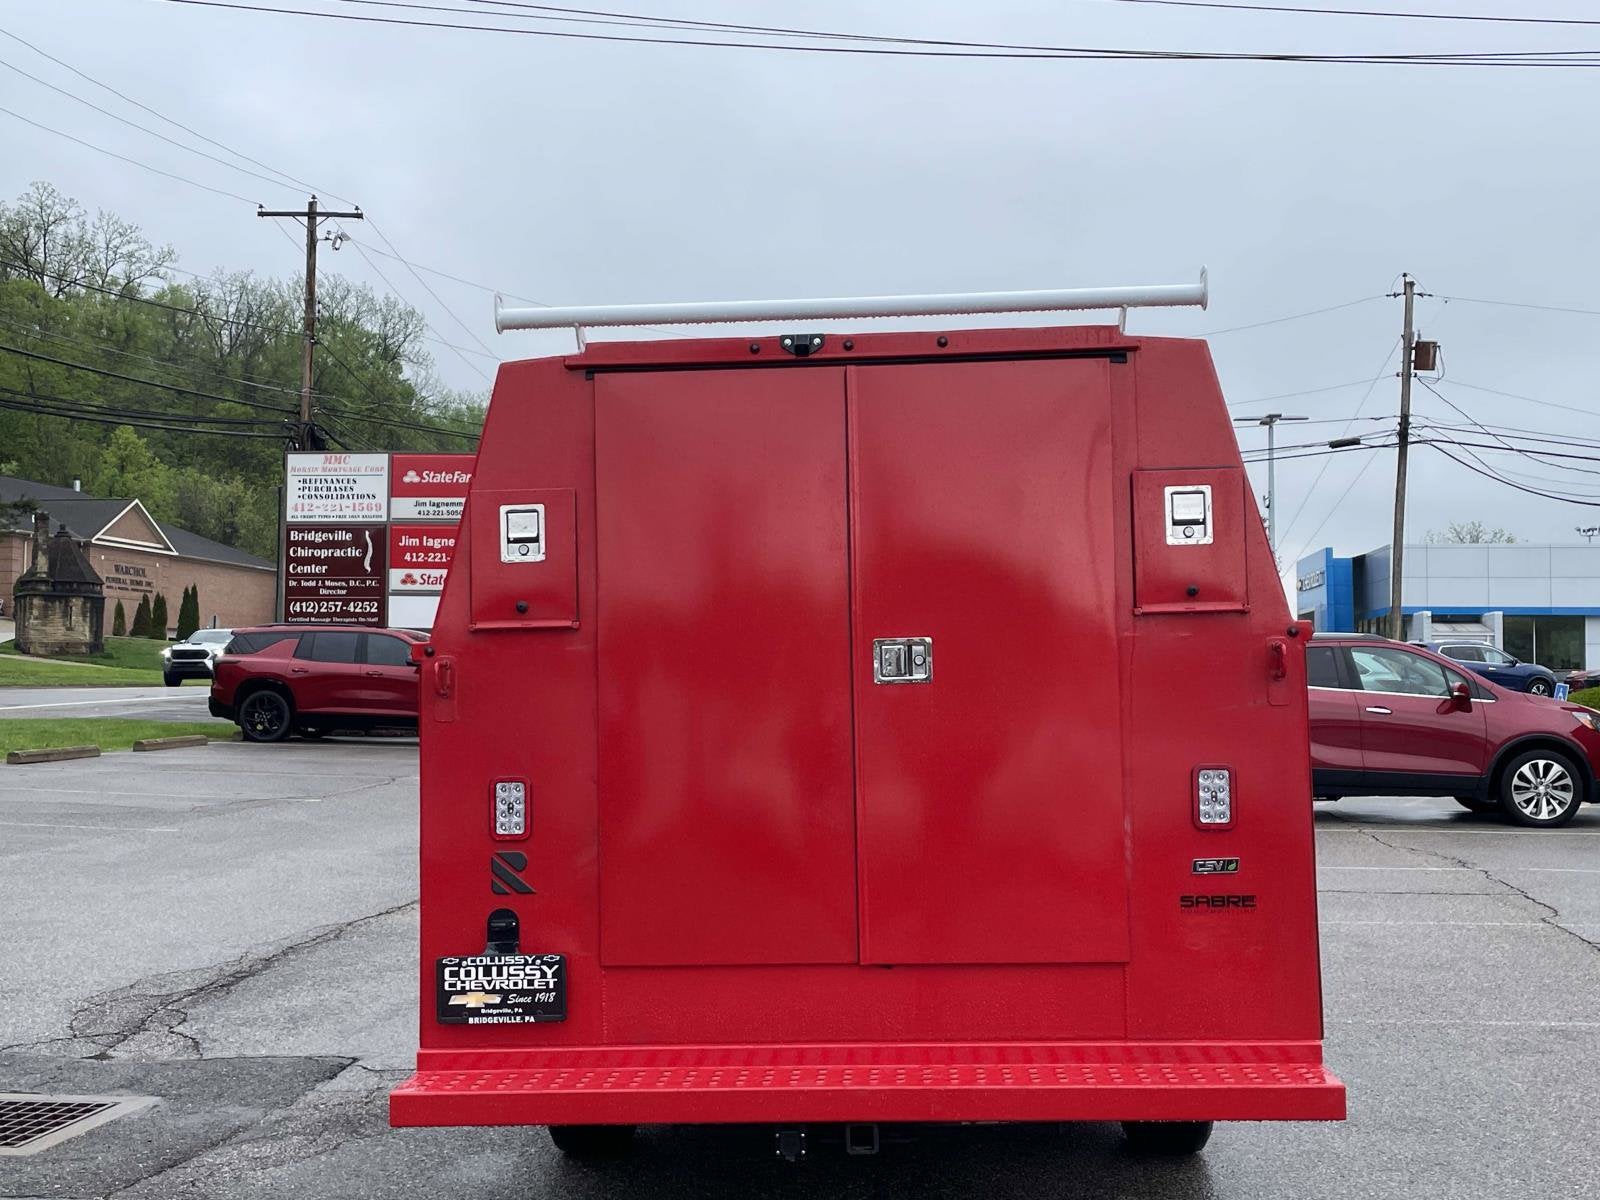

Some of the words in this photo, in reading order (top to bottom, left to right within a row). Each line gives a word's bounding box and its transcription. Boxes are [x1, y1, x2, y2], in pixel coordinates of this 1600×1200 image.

[323, 455, 351, 465] MMC
[421, 470, 472, 483] StateFar
[292, 502, 382, 512] 412-221-1569
[429, 500, 463, 509] Iagnemm
[290, 530, 352, 543] Bridgeville
[398, 536, 419, 547] Jim
[423, 536, 455, 549] Iagne
[289, 546, 362, 559] Chiropractic
[404, 553, 450, 562] 412-221-
[114, 564, 147, 577] WARCHOL
[289, 563, 328, 574] Center
[106, 576, 128, 585] FUNERAL
[130, 579, 144, 587] HOME
[419, 573, 443, 585] Stat
[1180, 895, 1257, 908] SABRE
[467, 955, 535, 965] COLUSSY
[444, 965, 559, 981] COLUSSY
[444, 978, 557, 991] CHEVROLET
[507, 993, 532, 1004] Since
[535, 992, 556, 1003] 1918
